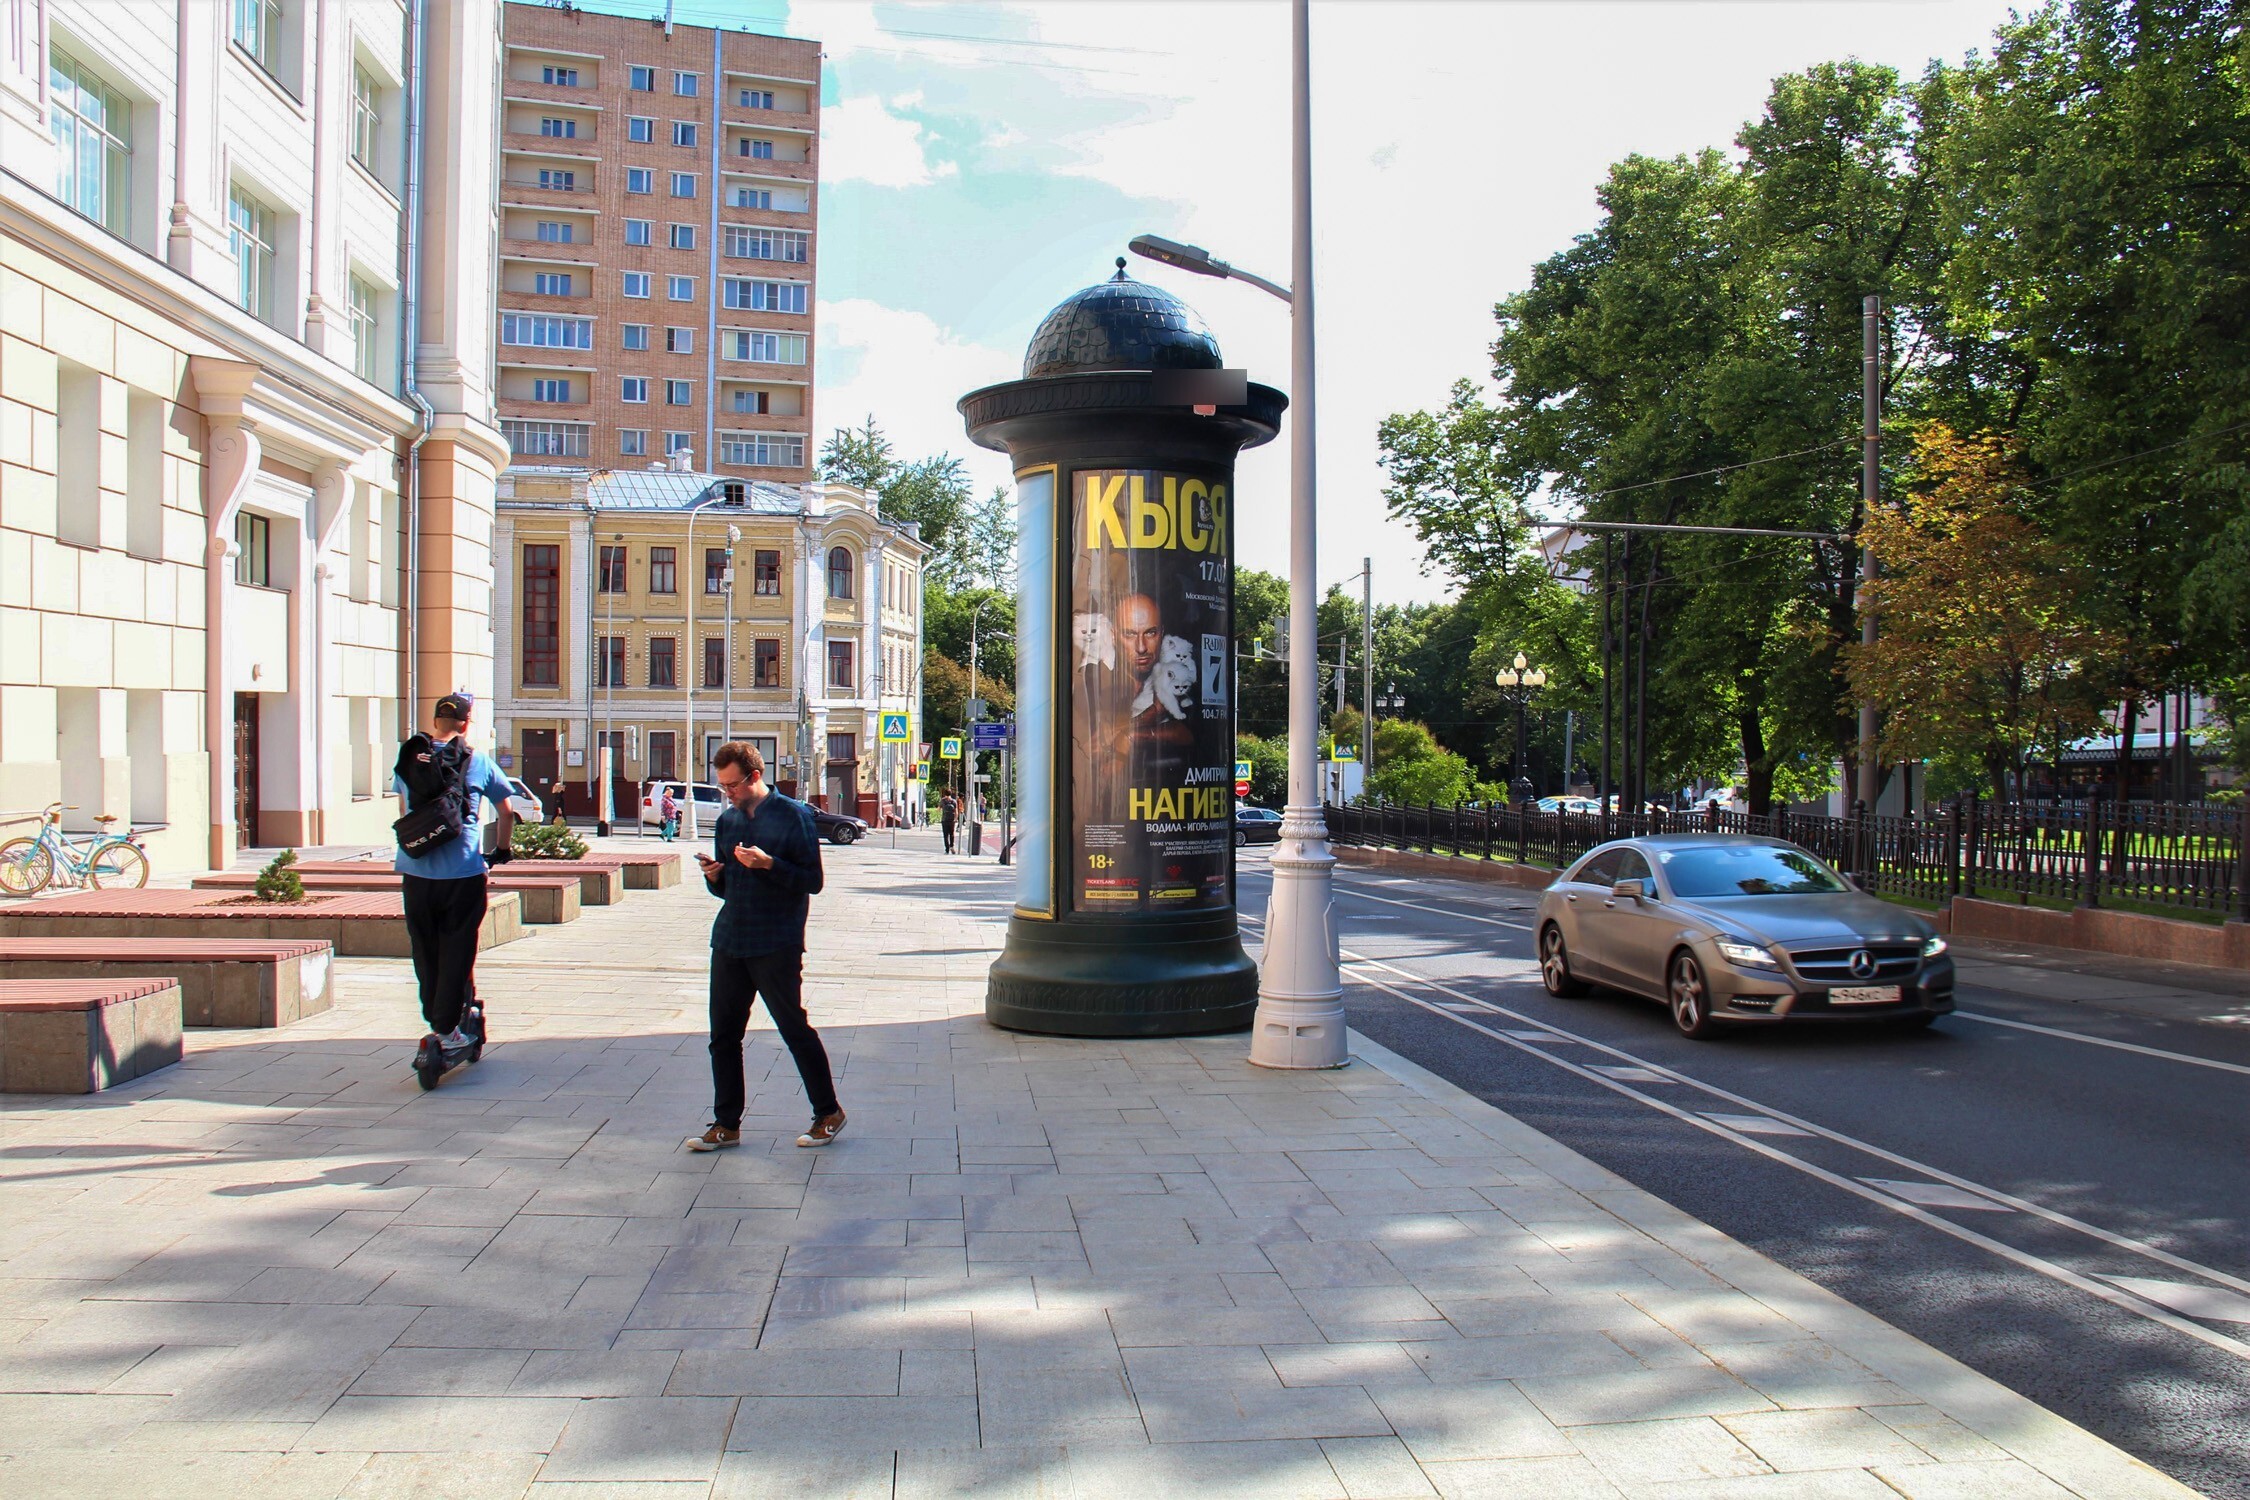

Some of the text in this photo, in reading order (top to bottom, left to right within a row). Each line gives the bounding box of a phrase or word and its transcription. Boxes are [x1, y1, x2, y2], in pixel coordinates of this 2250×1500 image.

[1087, 476, 1226, 557] КЫСЯ
[1210, 655, 1222, 695] 7
[1201, 708, 1219, 719] 104.7
[1129, 787, 1228, 820] НАГИЕВ
[405, 824, 447, 849] NIKE AIR
[1146, 823, 1182, 834] ВОДИЛА
[1187, 821, 1209, 832] ИГОРЬ
[1088, 854, 1115, 869] 18+
